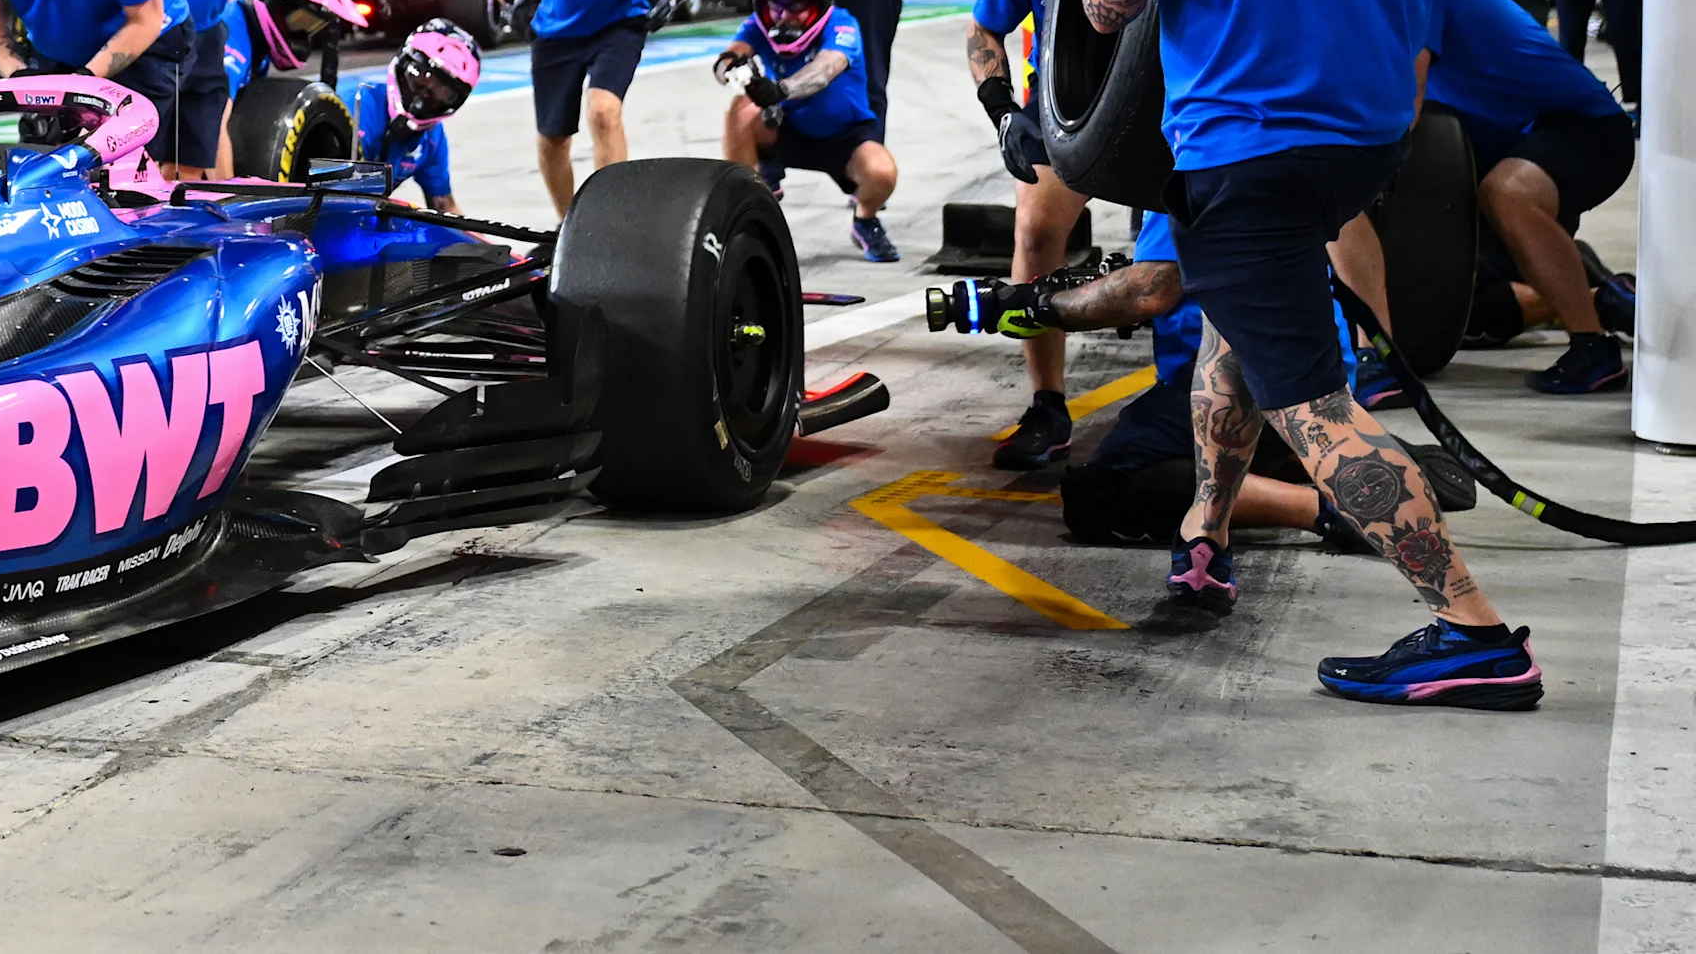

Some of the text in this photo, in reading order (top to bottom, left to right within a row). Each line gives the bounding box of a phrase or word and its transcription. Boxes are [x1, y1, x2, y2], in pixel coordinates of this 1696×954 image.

[35, 96, 56, 104] BWT
[57, 200, 88, 220] MODO
[65, 217, 100, 236] CASINO
[3, 515, 208, 602] JAAQ TRAK RACER MISSION Delphi
